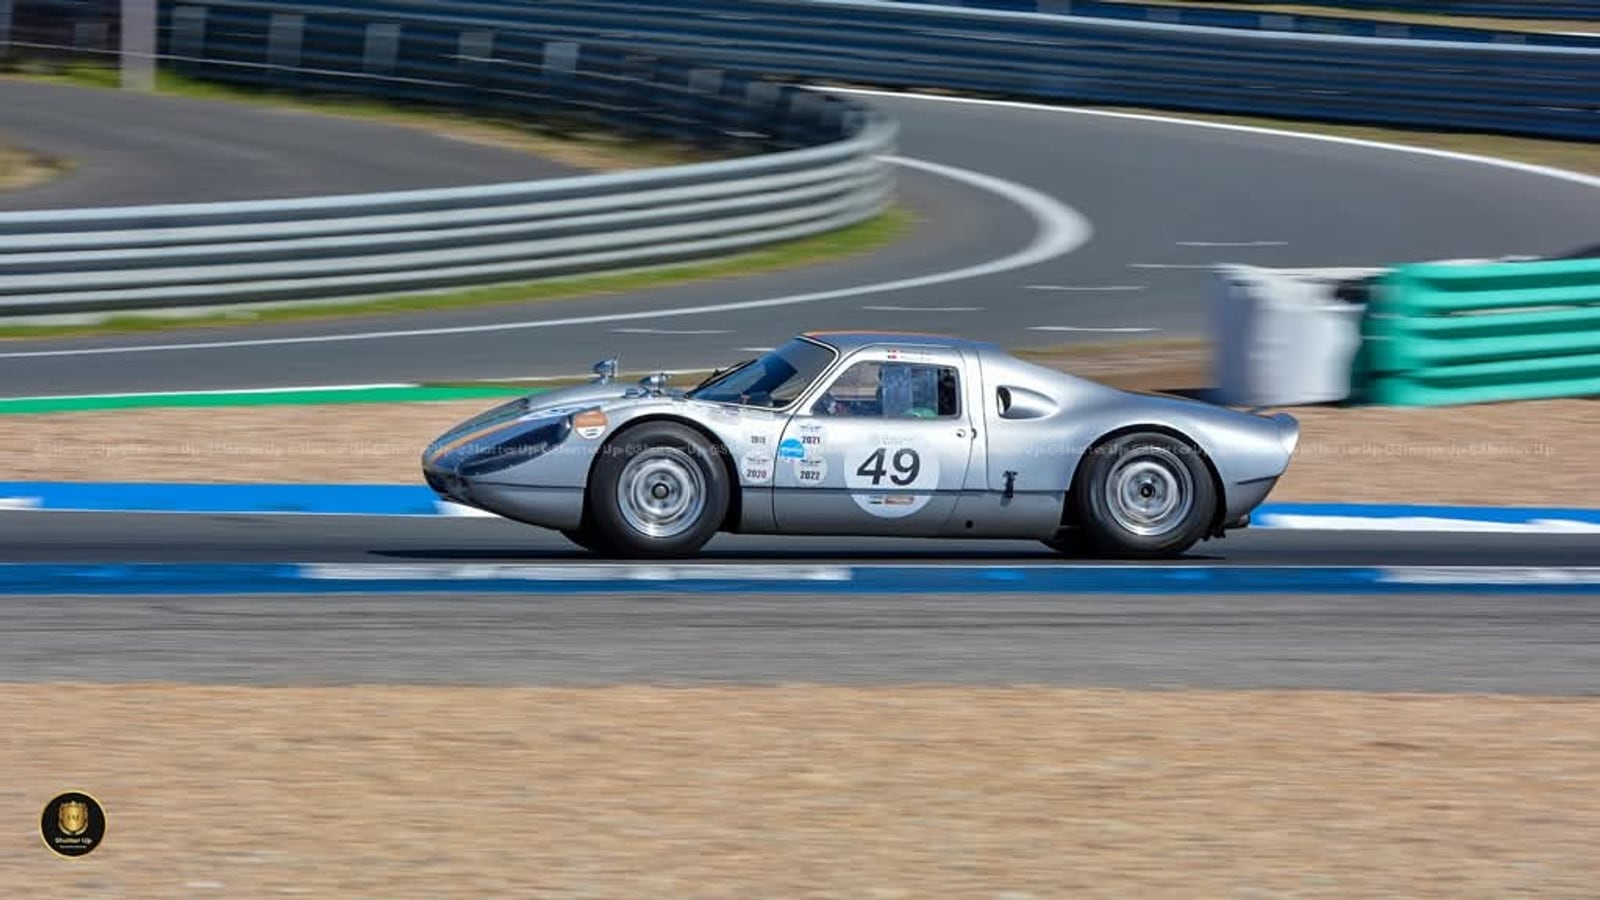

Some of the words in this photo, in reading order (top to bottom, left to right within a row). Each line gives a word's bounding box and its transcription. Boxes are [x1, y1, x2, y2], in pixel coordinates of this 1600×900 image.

[801, 435, 821, 445] 2021
[856, 447, 921, 486] 49
[746, 468, 768, 479] 2020
[799, 470, 821, 480] 2022
